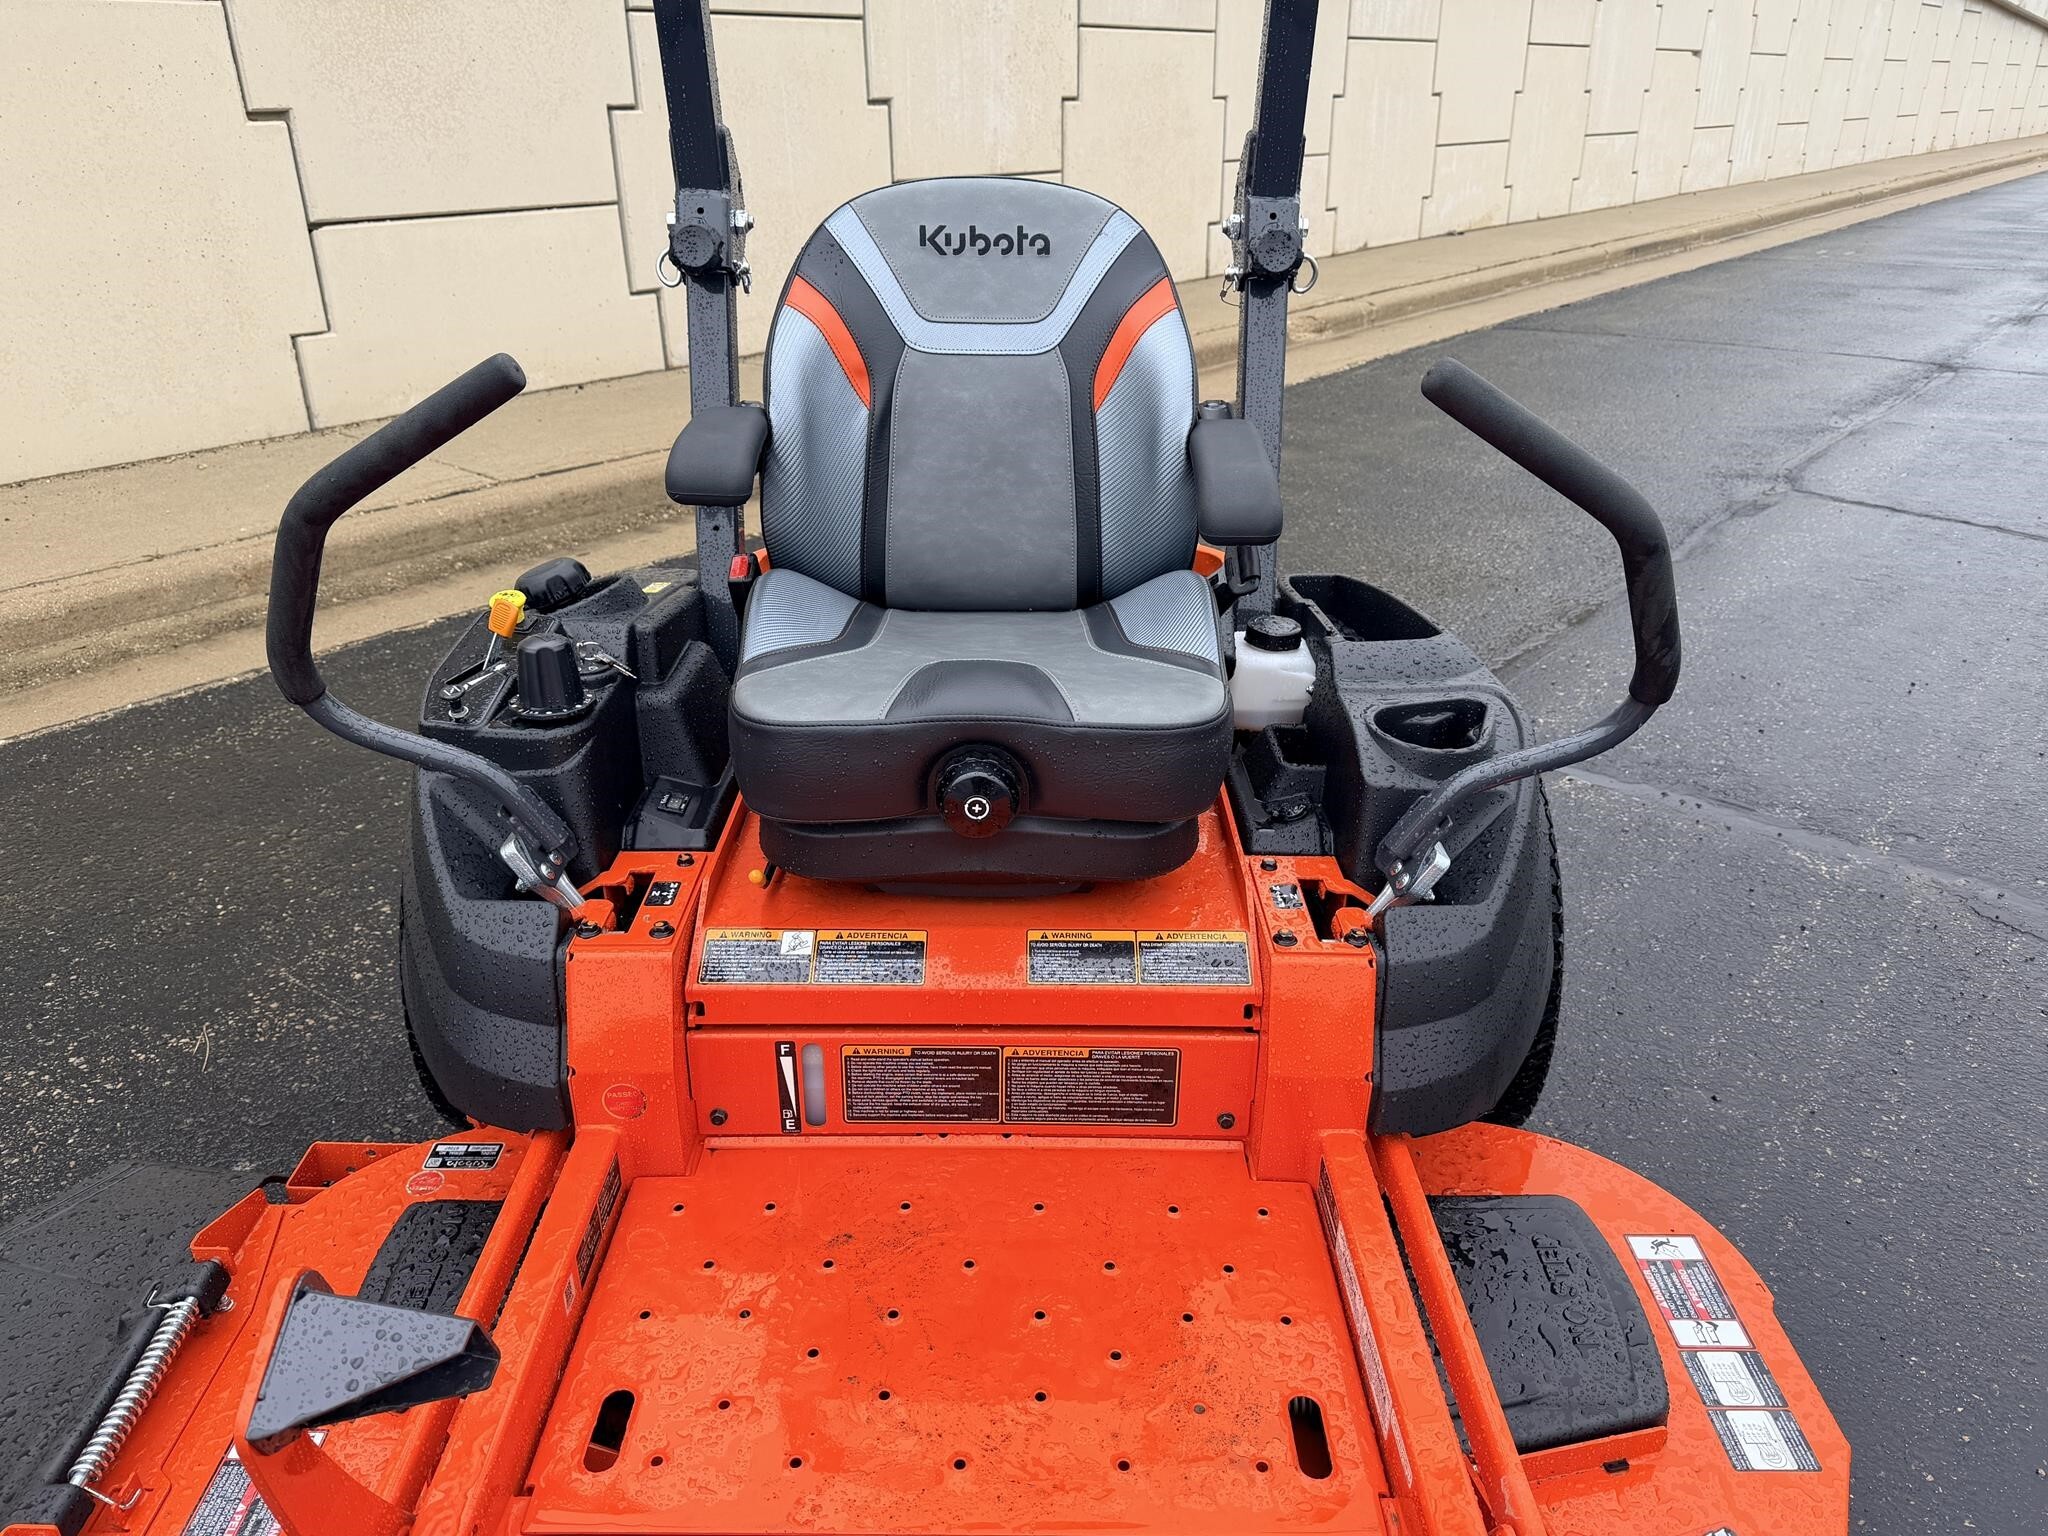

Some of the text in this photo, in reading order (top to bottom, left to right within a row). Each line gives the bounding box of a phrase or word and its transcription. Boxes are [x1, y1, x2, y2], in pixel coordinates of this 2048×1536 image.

[919, 224, 1051, 256] Kubota
[730, 931, 772, 939] WARNING
[846, 932, 908, 940] ADVERTENCIA
[780, 1044, 790, 1055] F
[785, 1119, 796, 1130] E
[446, 1160, 490, 1168] Kubota
[1642, 1269, 1664, 1300] DANGER
[1677, 1269, 1700, 1300] PELIGRO
